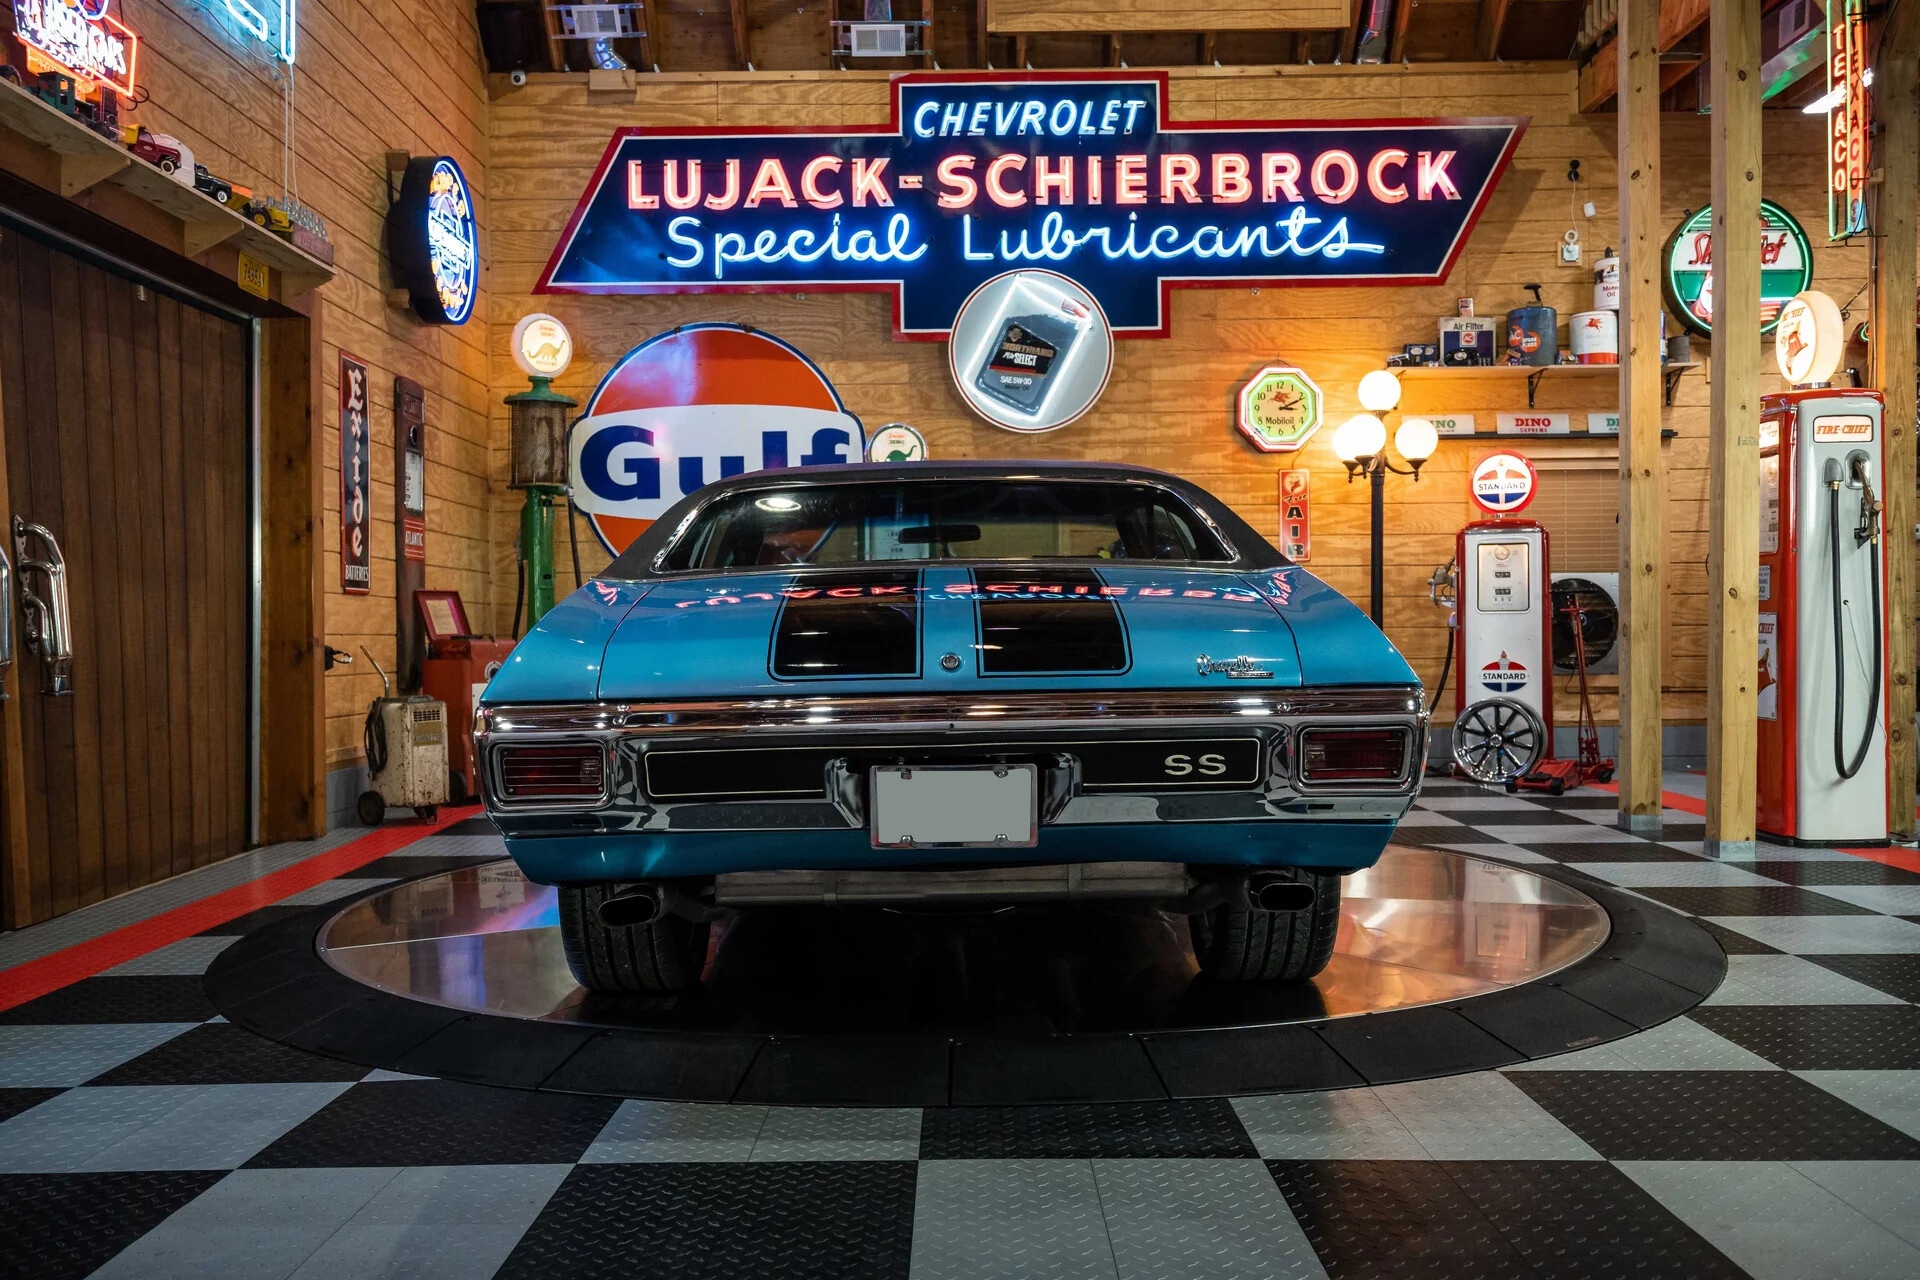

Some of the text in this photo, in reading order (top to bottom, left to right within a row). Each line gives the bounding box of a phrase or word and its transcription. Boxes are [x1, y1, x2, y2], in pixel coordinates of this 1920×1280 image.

[1833, 24, 1847, 191] TEACO
[913, 99, 1147, 138] CHEVROLET
[666, 206, 1385, 279] Special Lubricants
[1453, 322, 1485, 331] Air Filter
[1014, 352, 1038, 367] SELECT
[1000, 375, 1013, 384] SAE
[1276, 381, 1285, 389] 12
[1257, 392, 1266, 400] 10
[1258, 417, 1263, 425] 8
[1265, 416, 1295, 425] Mobiloil
[1514, 417, 1552, 427] DINO
[1816, 424, 1871, 435] FIRE-CHIEF
[348, 368, 363, 558] Exide
[580, 425, 849, 501] Gulf
[1478, 482, 1526, 491] STANDARD
[1286, 506, 1305, 556] AIR
[405, 531, 424, 548] ATLANTIC
[345, 563, 369, 582] BATTERIES
[1482, 672, 1526, 680] STANDARD
[1164, 754, 1227, 776] SS
